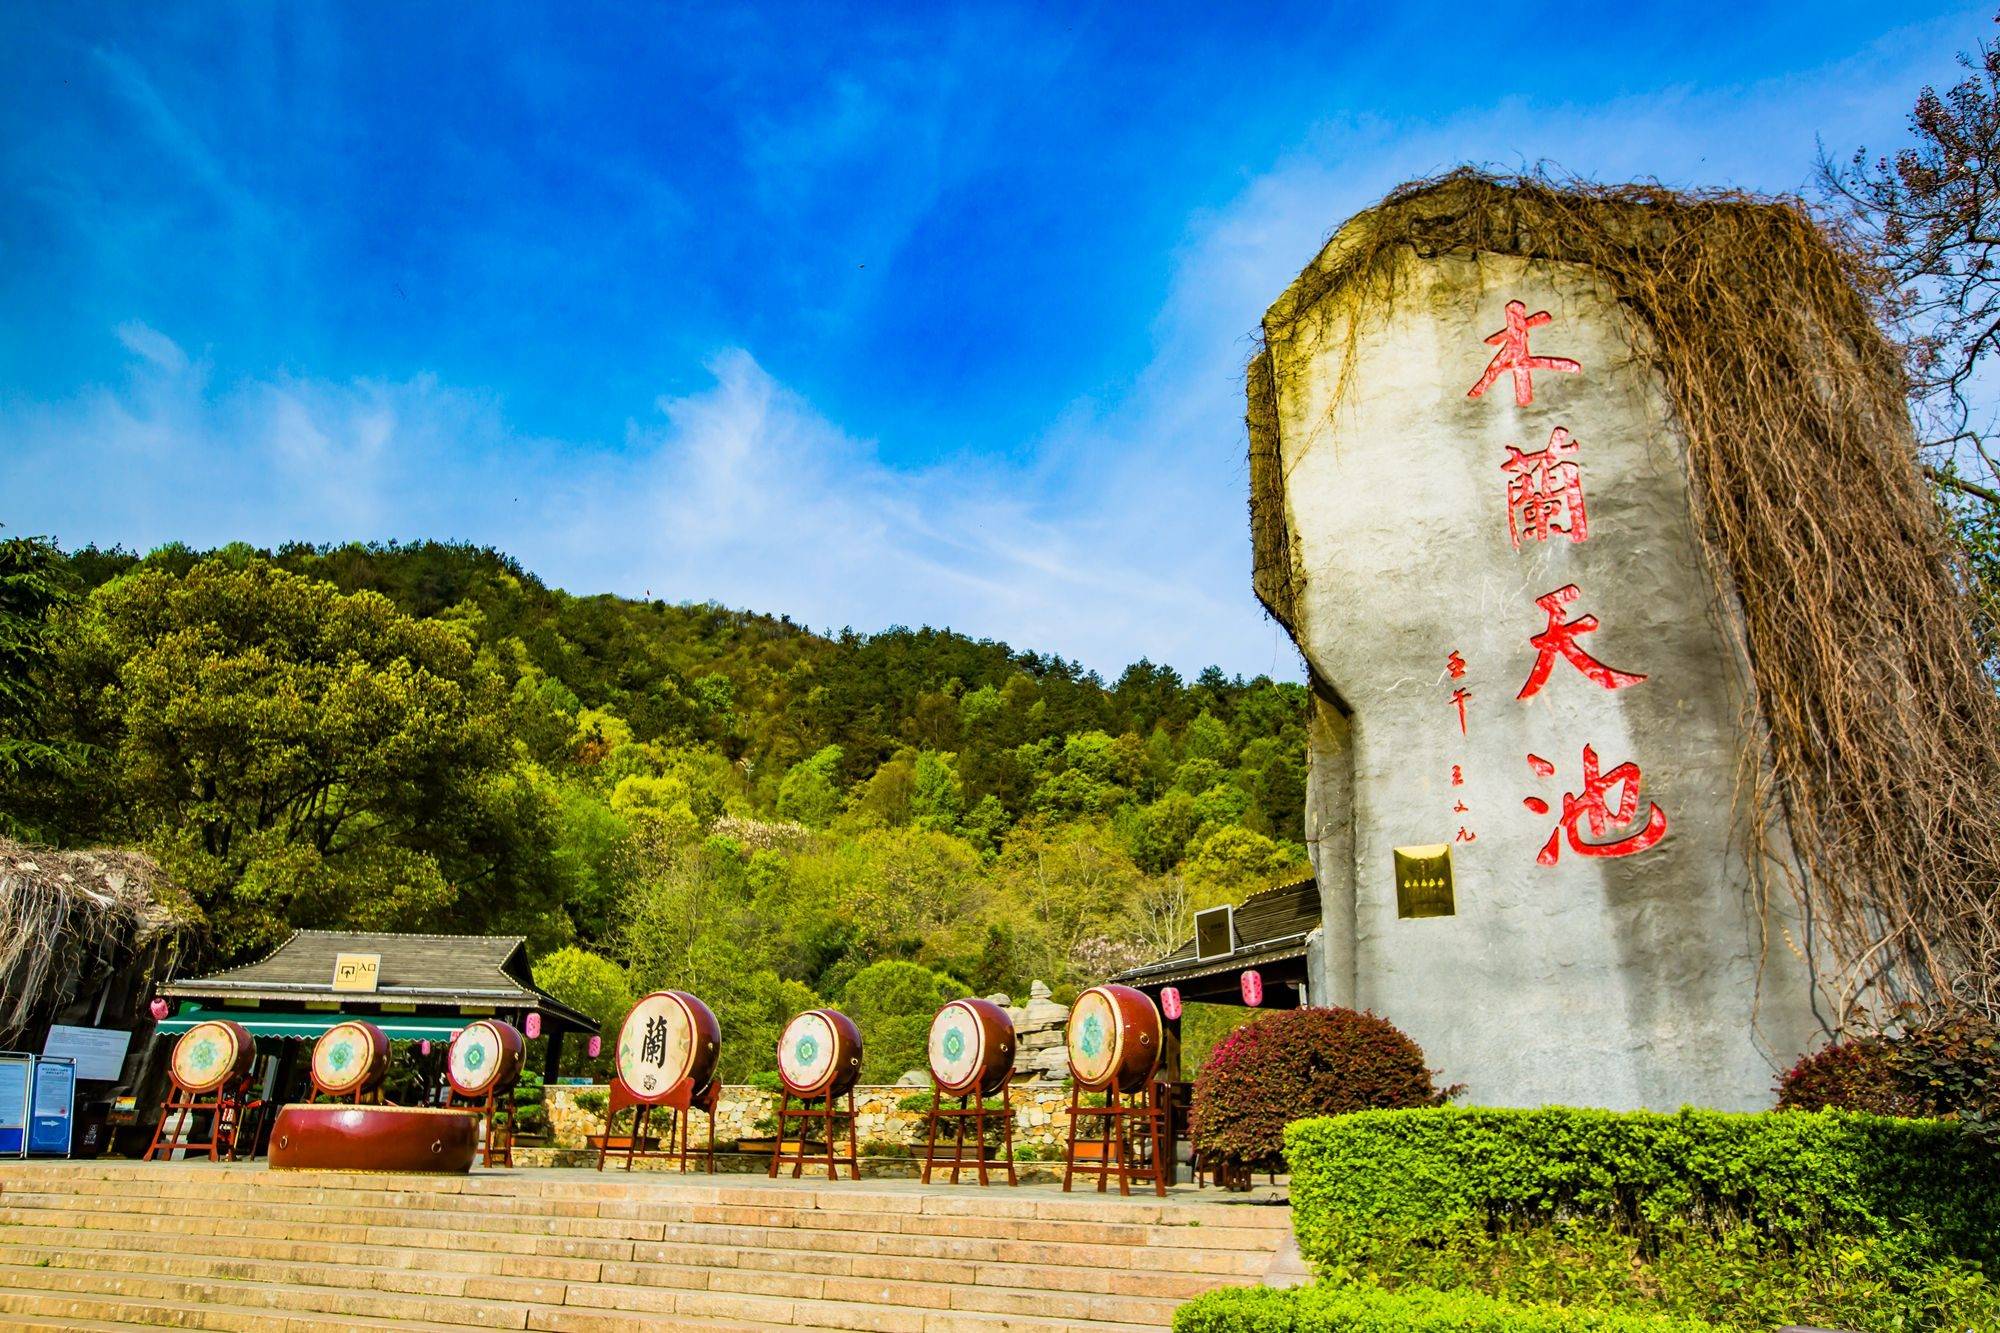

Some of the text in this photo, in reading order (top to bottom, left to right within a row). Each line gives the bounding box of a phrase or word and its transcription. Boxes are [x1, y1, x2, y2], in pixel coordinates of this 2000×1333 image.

[1467, 299, 1668, 867] 木蘭天池
[359, 963, 376, 971] 入口
[641, 1015, 667, 1069] 蘭
